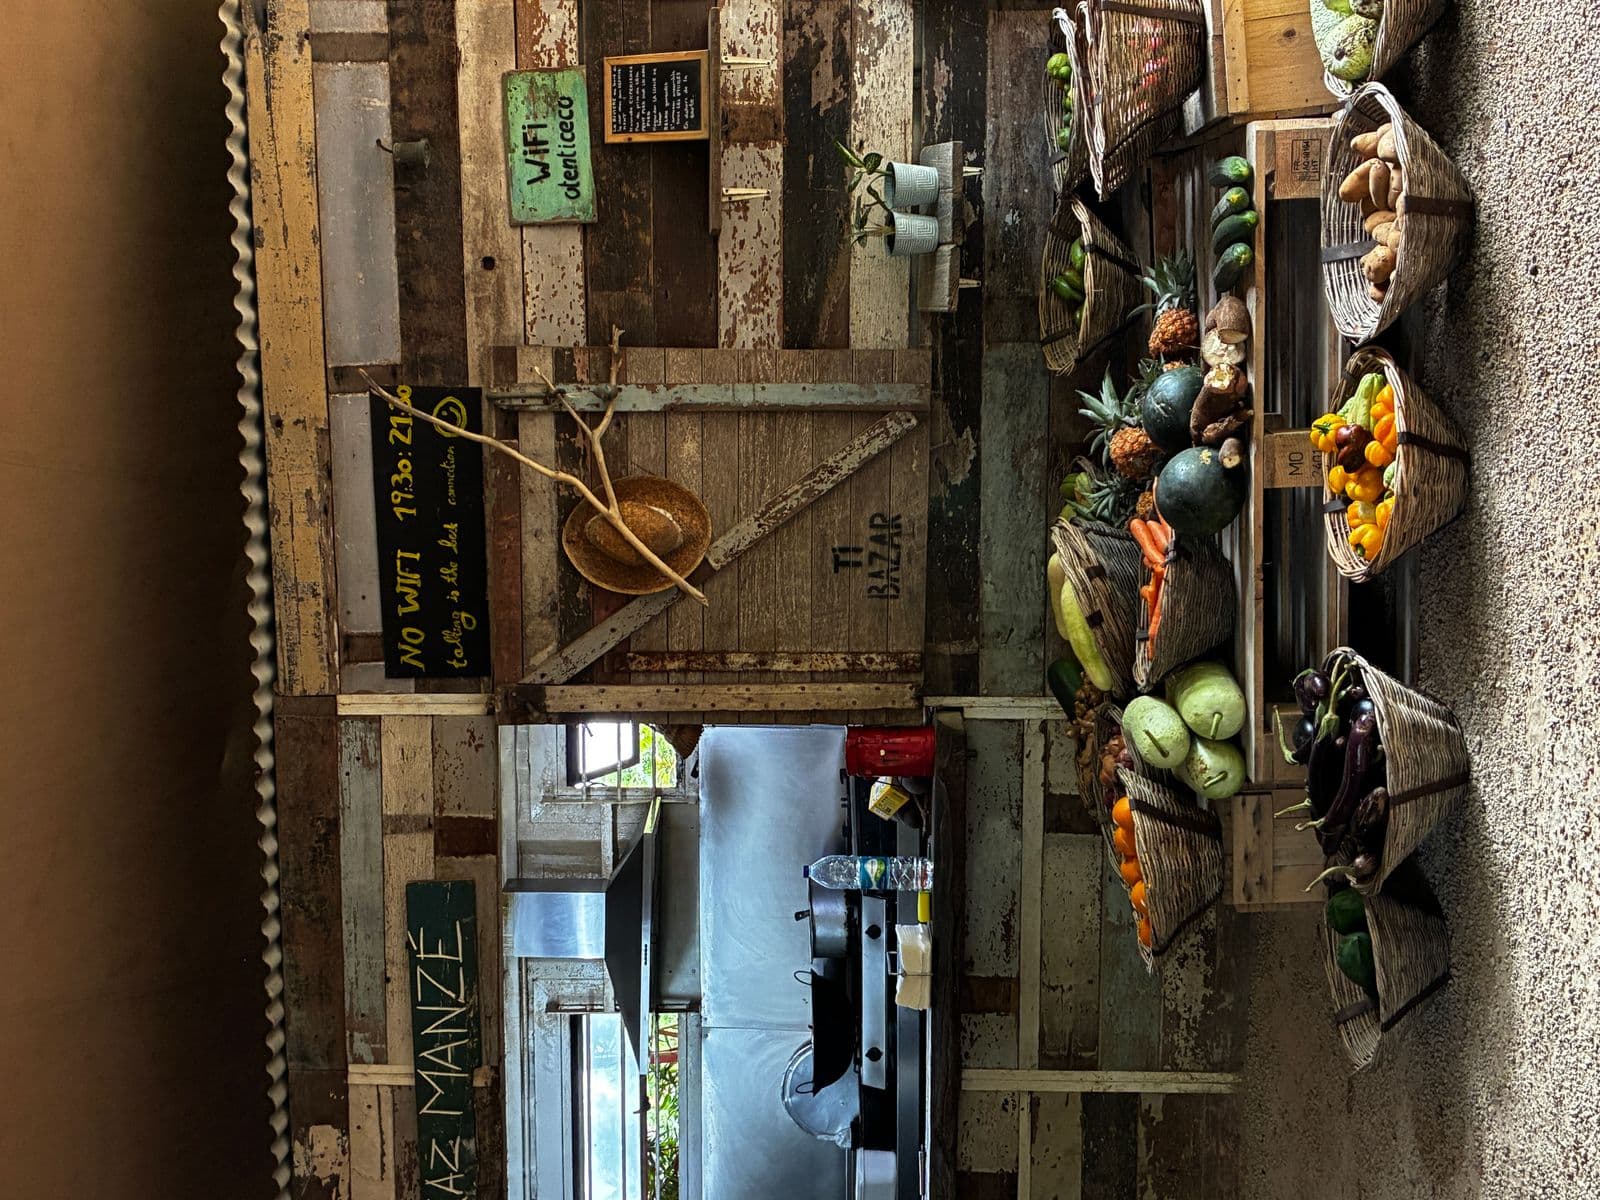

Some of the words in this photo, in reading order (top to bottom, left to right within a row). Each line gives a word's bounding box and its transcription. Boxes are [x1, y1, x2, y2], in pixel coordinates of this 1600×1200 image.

[522, 124, 550, 185] WiFi
[440, 446, 456, 505] connection
[437, 523, 458, 555] best
[867, 512, 901, 599] BAZAR
[396, 548, 422, 616] WIFI
[440, 561, 457, 586] the
[446, 590, 459, 602] is
[399, 628, 426, 670] NO
[408, 920, 469, 1115] MANZÉ
[425, 1136, 468, 1200] AZ
